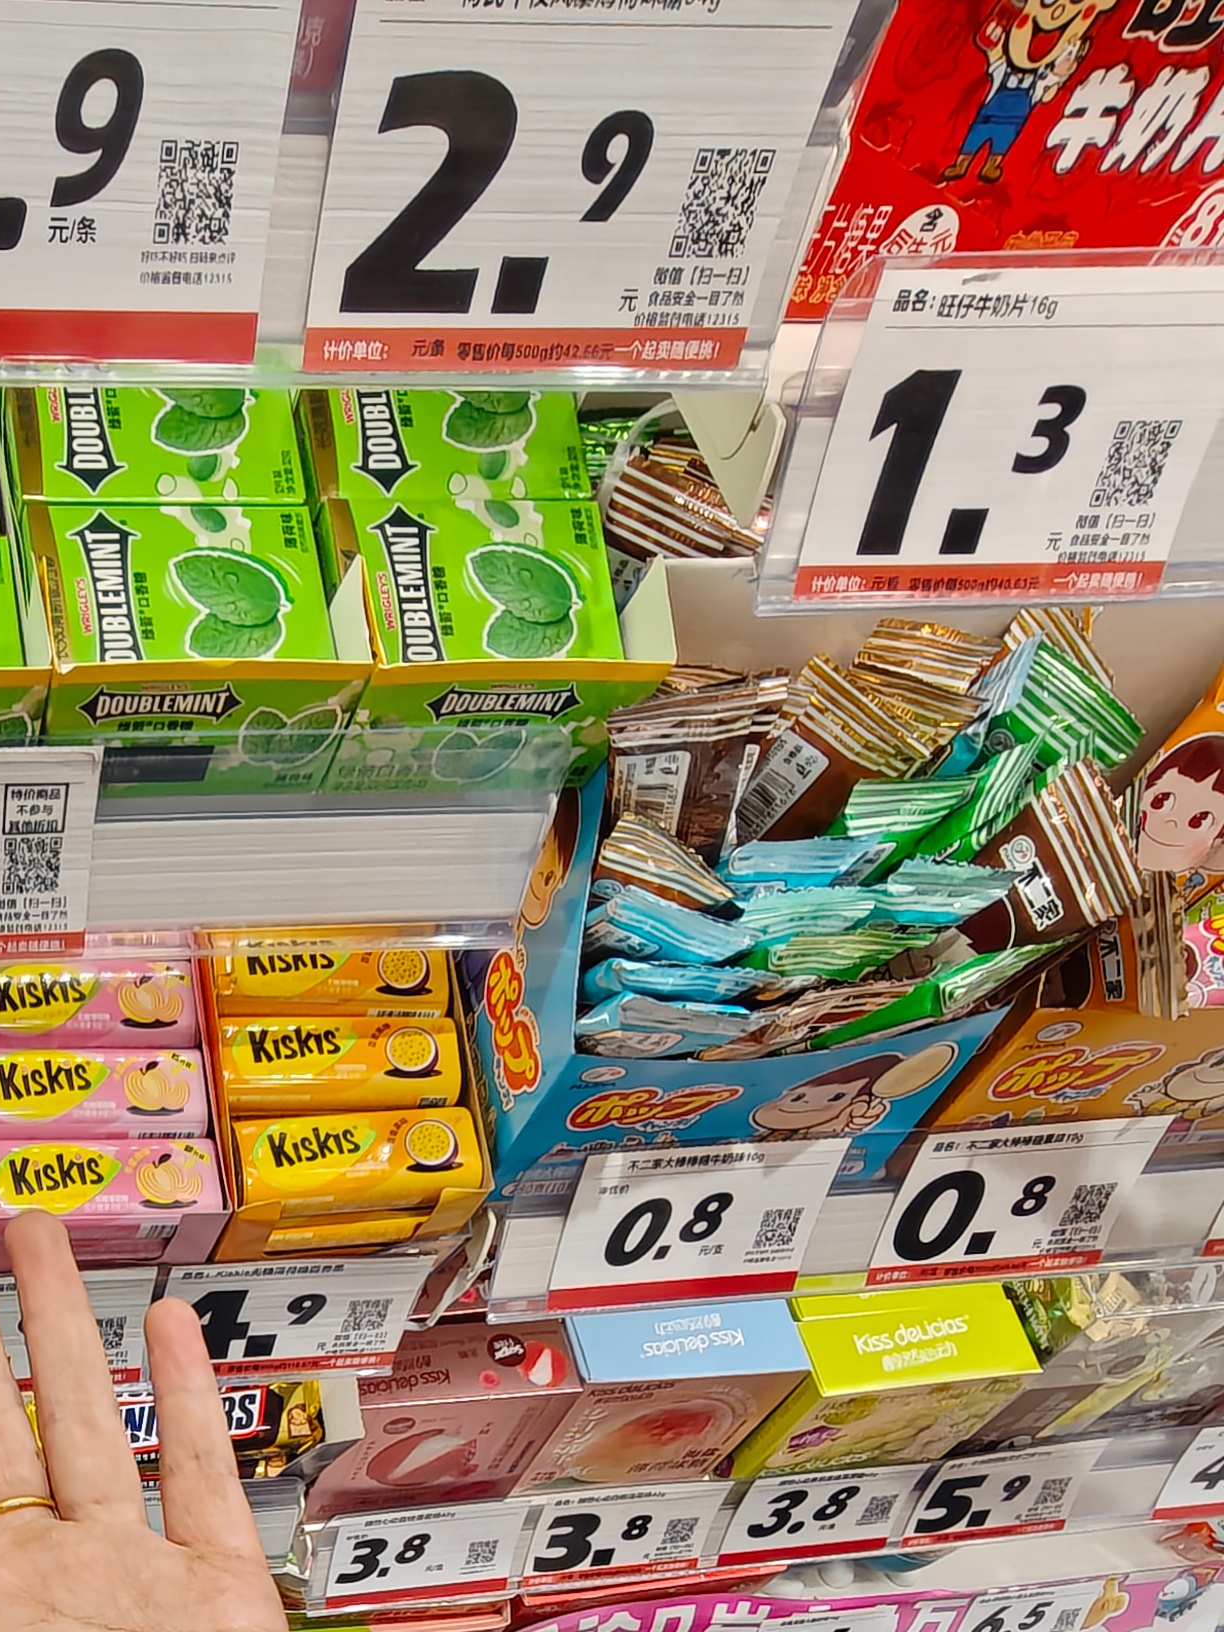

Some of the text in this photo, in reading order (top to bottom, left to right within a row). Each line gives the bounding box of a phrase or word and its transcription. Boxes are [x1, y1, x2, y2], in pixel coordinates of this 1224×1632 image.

[339, 70, 654, 314] 2.9
[47, 216, 97, 244] 元/条
[619, 288, 638, 313] 元
[937, 294, 1059, 321] 旺仔牛奶片16g
[856, 369, 1087, 556] 1.3
[1045, 532, 1063, 550] 元
[74, 577, 93, 634] WRIGLEY'S
[376, 572, 395, 631] WRIGLEY'S
[95, 688, 232, 717] DOUBLEMINT
[438, 686, 569, 713] DOUBLEMINT
[250, 1025, 343, 1065] Kiskis
[0, 1060, 92, 1101] Kiskis
[269, 1126, 362, 1169] Kiskis
[11, 1153, 106, 1196] Kiskis
[604, 1192, 734, 1267] 0.8
[893, 1169, 1056, 1262] 0.8
[192, 1289, 328, 1360] 4.9
[707, 1327, 745, 1346] Kiss
[852, 1330, 892, 1357] Kiss
[746, 1484, 862, 1539] 3.8
[914, 1473, 1032, 1535] 5.9
[334, 1532, 432, 1585] 3.8
[533, 1513, 653, 1574] 3.8
